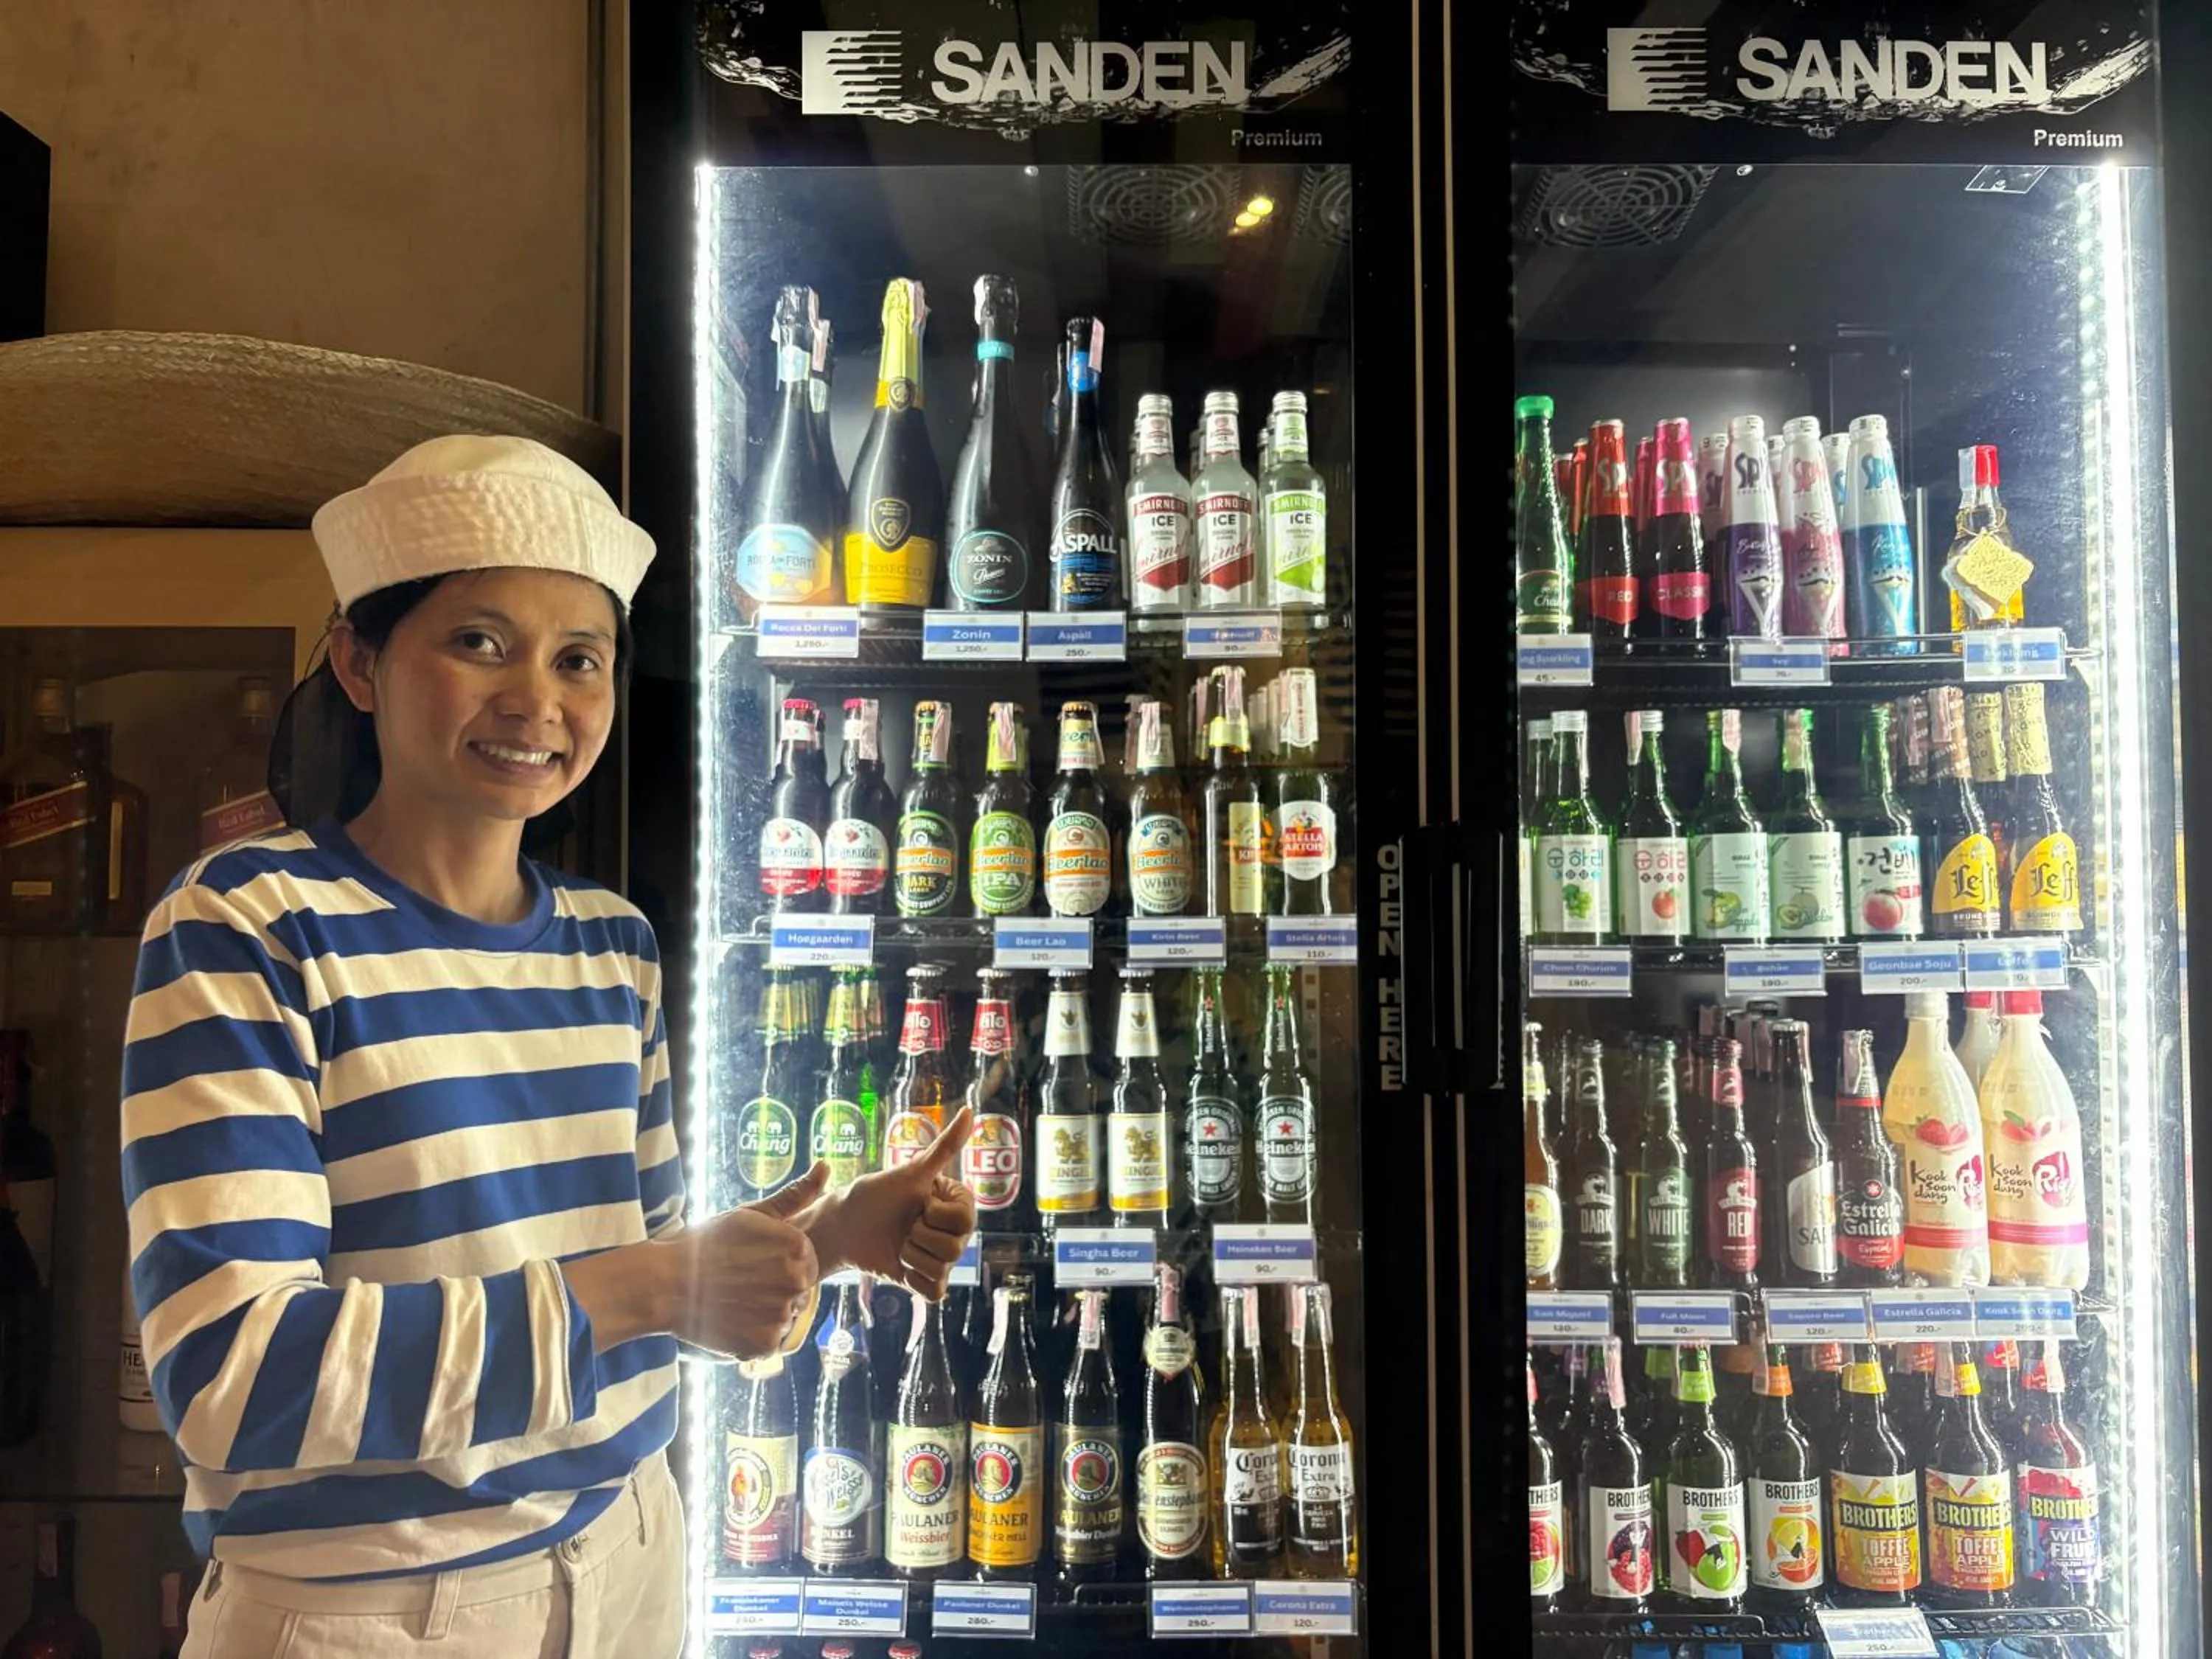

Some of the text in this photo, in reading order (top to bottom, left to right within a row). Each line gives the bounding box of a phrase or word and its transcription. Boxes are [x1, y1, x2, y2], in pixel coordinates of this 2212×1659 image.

[931, 39, 1246, 105] SANDEN
[1736, 37, 2049, 103] SANDEN
[1231, 129, 1322, 146] Premium
[2034, 128, 2124, 147] Premium
[1152, 515, 1175, 526] ICE
[1214, 514, 1237, 526] ICE
[1290, 512, 1313, 524] ICE
[1050, 533, 1116, 561] ASPALL
[966, 554, 1012, 564] ZONIN
[952, 630, 991, 640] Zonin
[1284, 832, 1324, 843] STELLA
[1284, 842, 1325, 852] ARTOIS
[983, 873, 1022, 887] IPA
[1377, 844, 1401, 956] OPEN
[787, 933, 853, 945] Hoegaarden
[1016, 936, 1067, 946] Beer Lao
[1868, 959, 1952, 971] Geonbae Soju
[1378, 978, 1402, 1091] HERE
[1186, 1142, 1242, 1155] eineken
[967, 1150, 1017, 1173] LEO
[1989, 1153, 2024, 1178] Kook
[1910, 1159, 1947, 1184] Kook
[1925, 1181, 1956, 1192] Soon
[2003, 1176, 2033, 1187] Soon
[1840, 1200, 1902, 1218] Estrella
[1580, 1208, 1613, 1234] DARK
[1647, 1208, 1690, 1235] WHITE
[1728, 1211, 1751, 1237] RED
[1844, 1217, 1901, 1237] Galicia
[1068, 1248, 1139, 1260] Singha Beer
[1883, 1307, 1963, 1317] Estrella Galicia
[1287, 1447, 1346, 1468] Corona
[1302, 1468, 1336, 1483] Extra
[1528, 1486, 1559, 1504] THERS
[1683, 1490, 1739, 1508] BROTHERS
[1765, 1481, 1820, 1500] BROTHERS
[1843, 1502, 1917, 1528] BROTHERS
[1863, 1537, 1910, 1557] TOFFEE
[1956, 1537, 2004, 1555] TOFFEE
[1863, 1556, 1910, 1567] APPLE
[1269, 1599, 1336, 1610] Corona Extra
